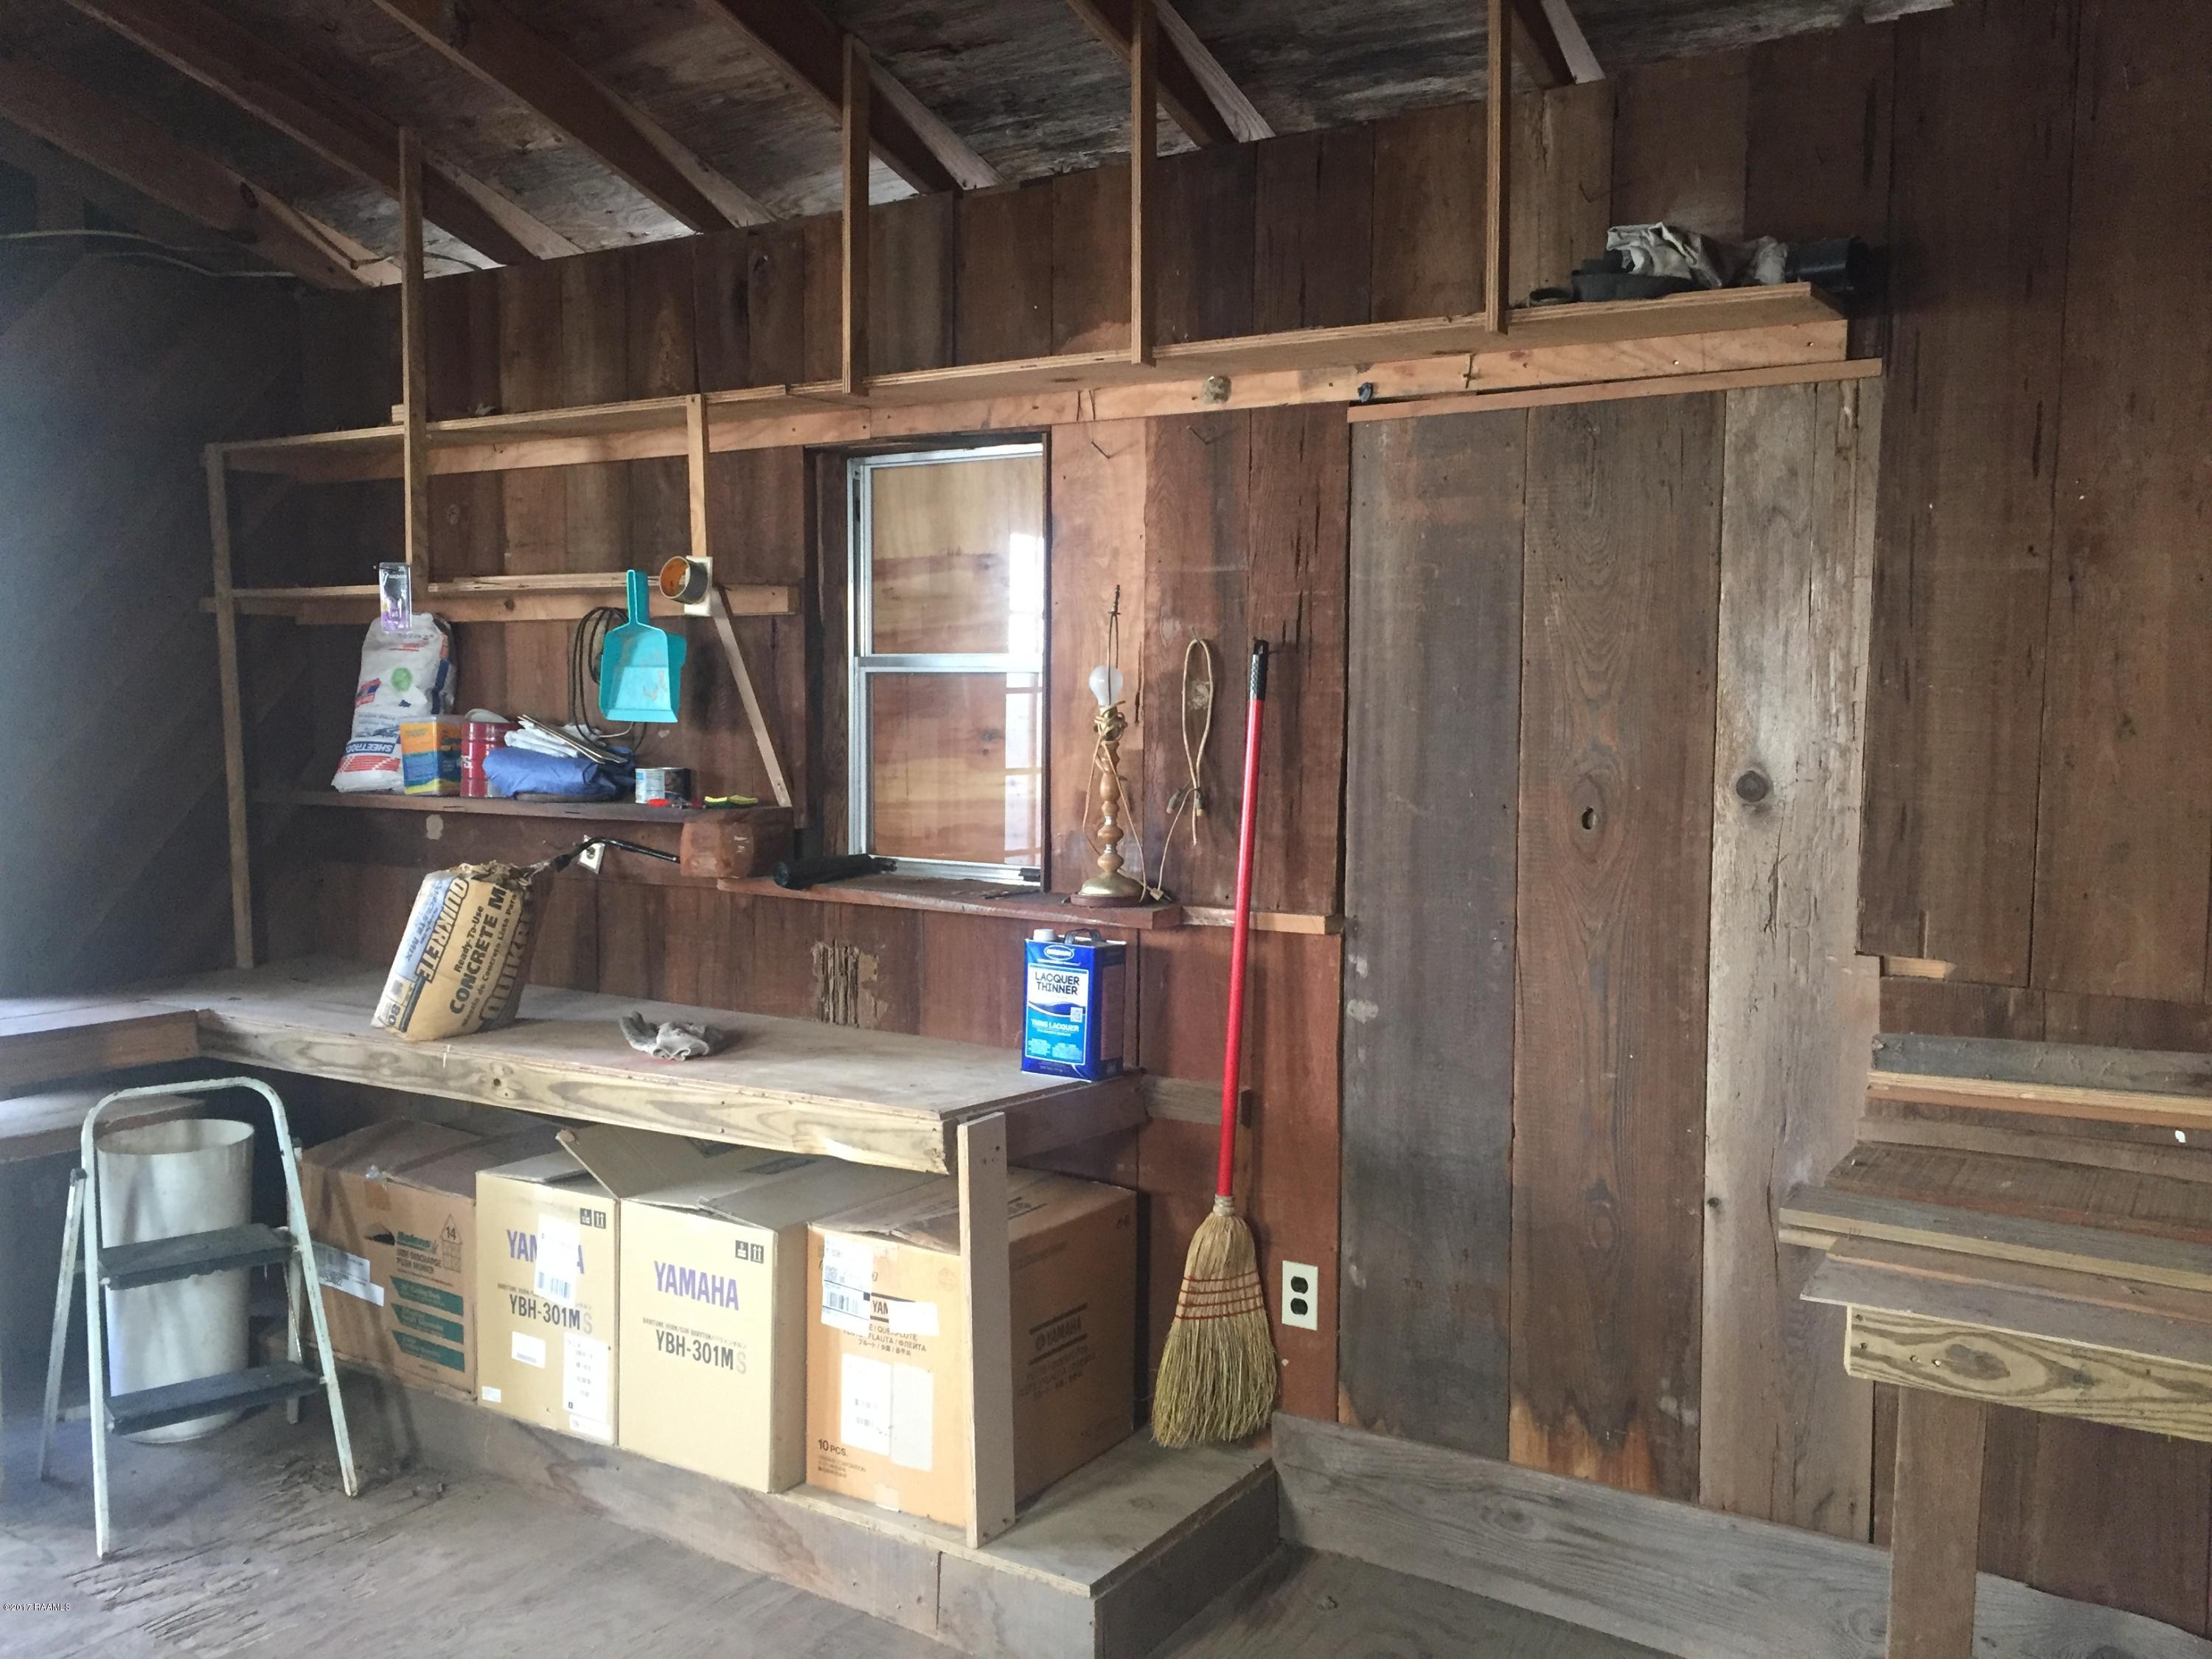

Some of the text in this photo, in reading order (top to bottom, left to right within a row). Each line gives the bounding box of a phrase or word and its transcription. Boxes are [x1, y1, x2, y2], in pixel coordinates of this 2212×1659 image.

[415, 877, 469, 984] QUIKRETE
[454, 905, 484, 973] Ready-To-Use
[477, 984, 487, 995] de
[482, 942, 502, 982] Concreto
[505, 894, 517, 915] Para
[450, 914, 498, 1015] CONCRETE
[1035, 971, 1080, 986] LACQUER
[1037, 981, 1078, 995] THINNER
[388, 1004, 401, 1026] 80
[446, 1226, 457, 1240] 14
[654, 1260, 739, 1311] YAMAHA
[1047, 1315, 1082, 1346] YAMAHA
[818, 1439, 829, 1451] 10
